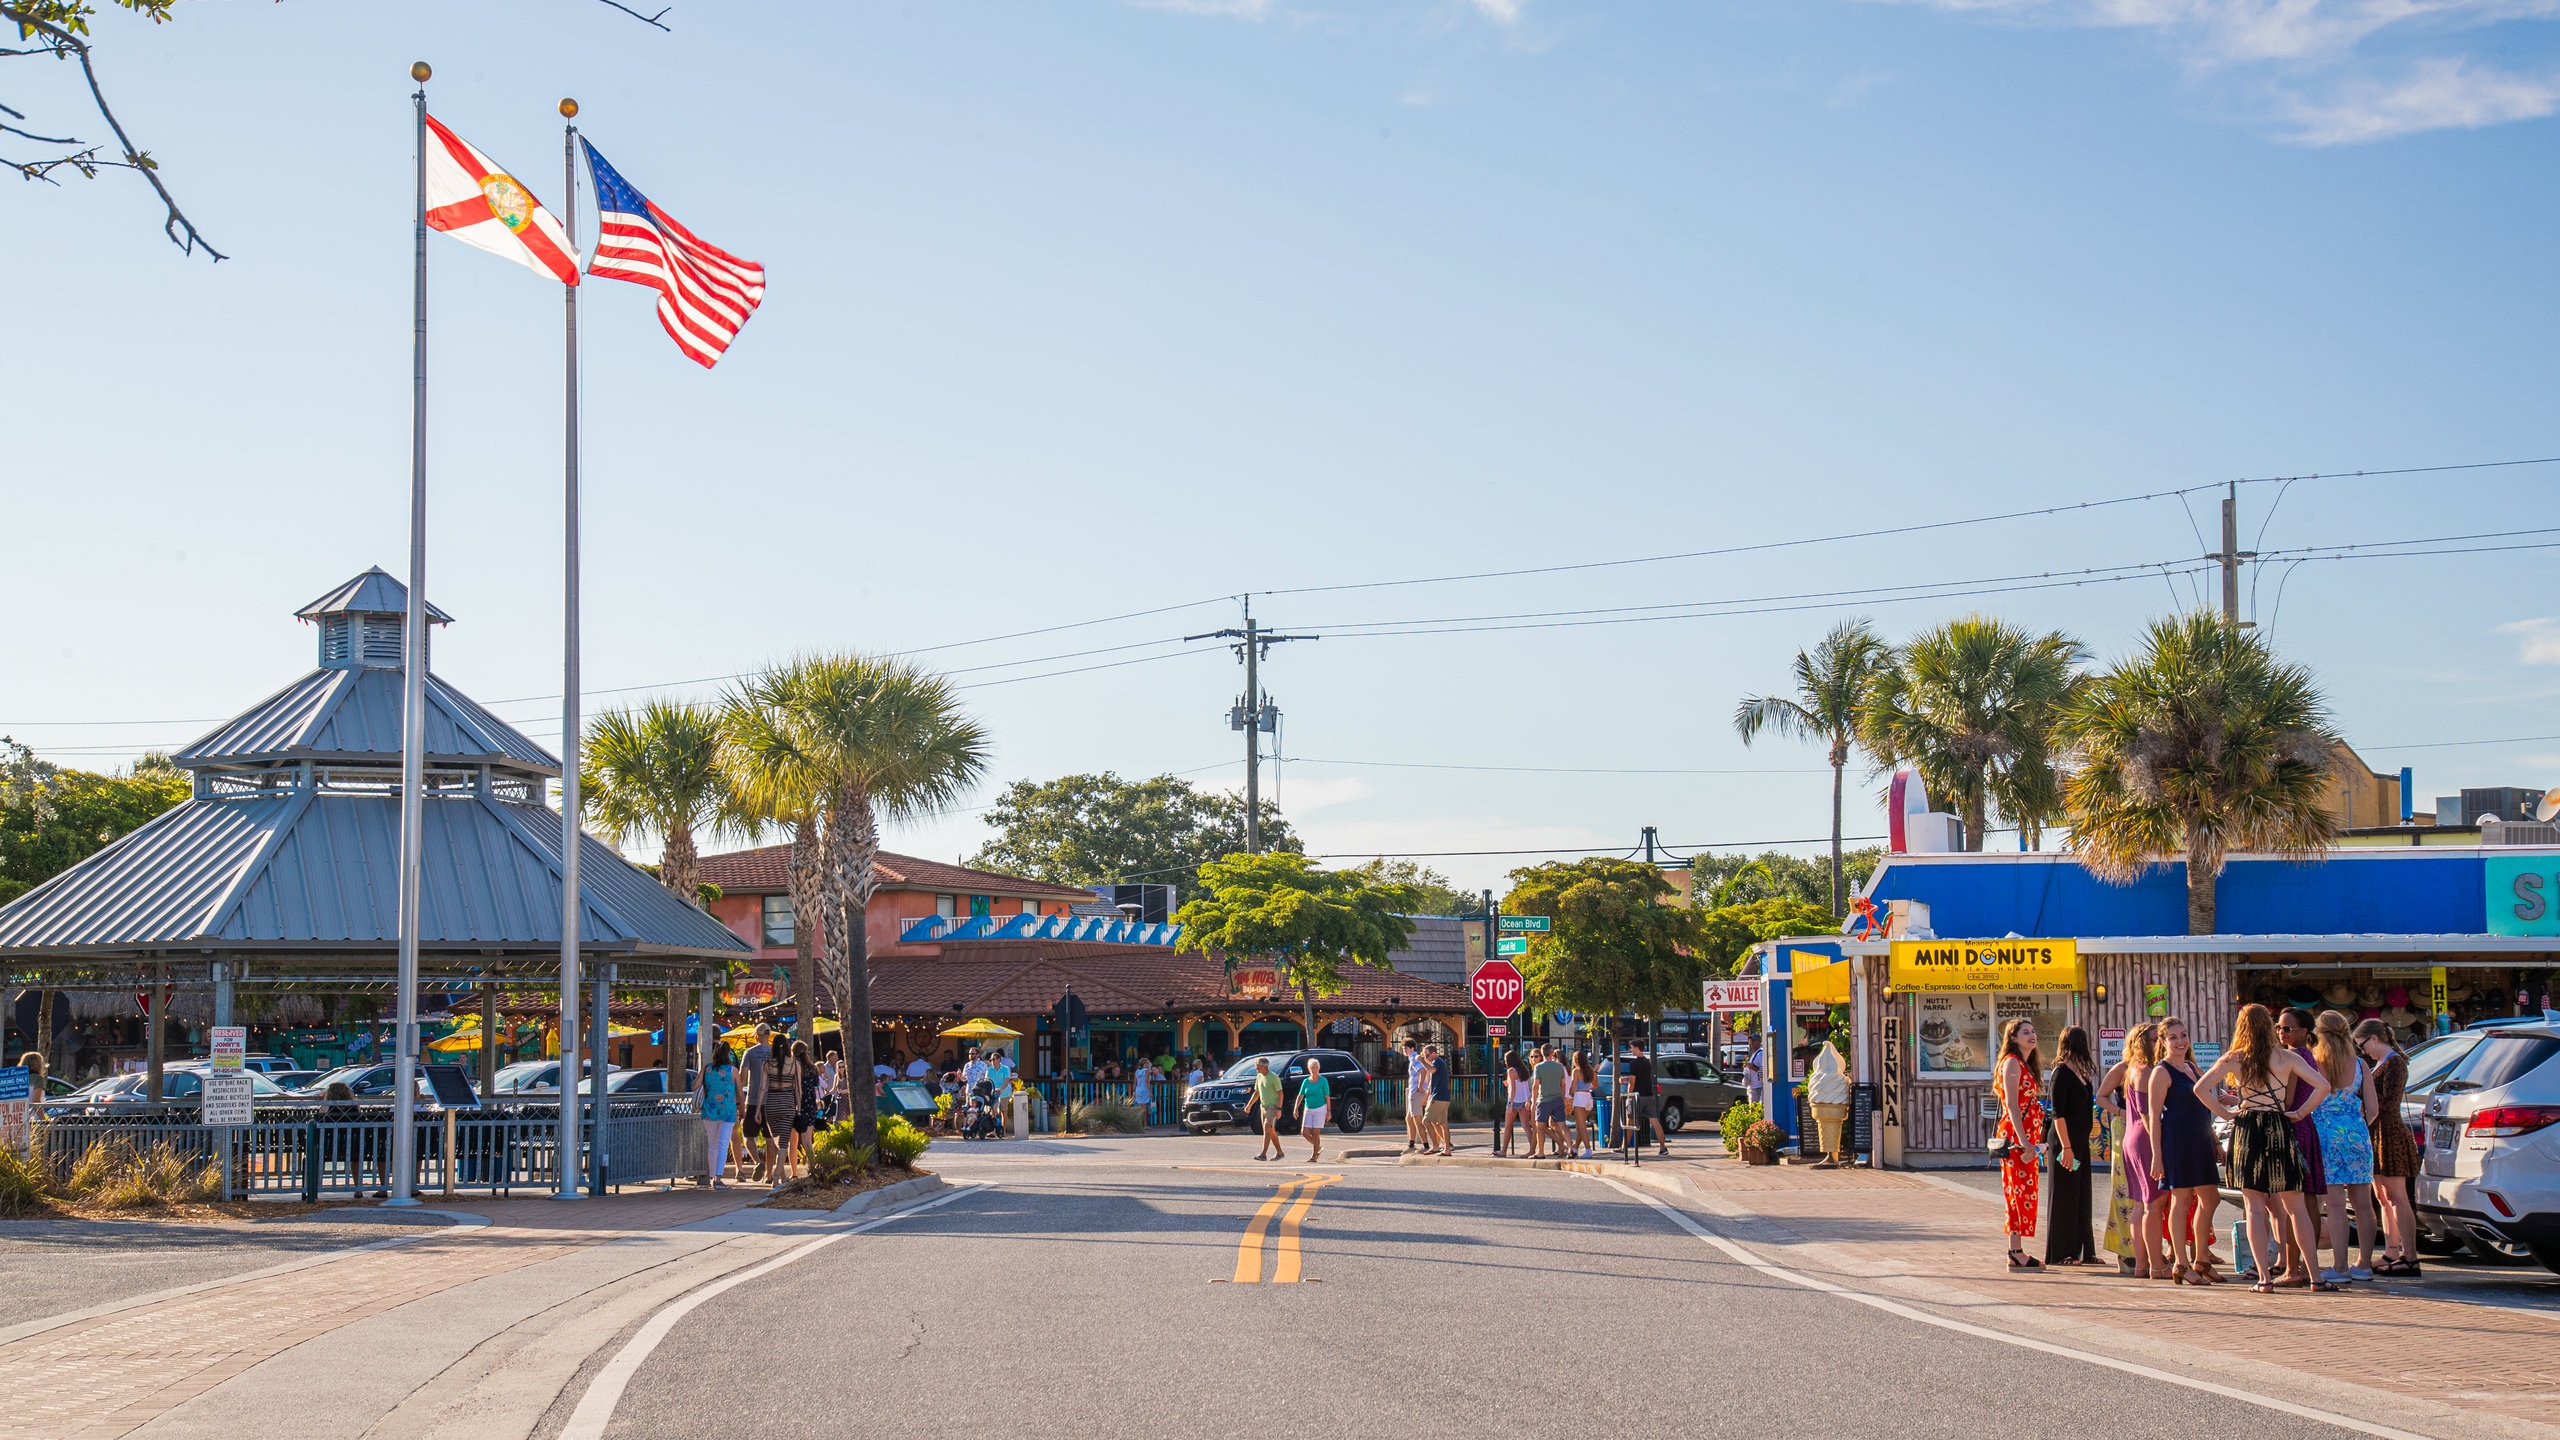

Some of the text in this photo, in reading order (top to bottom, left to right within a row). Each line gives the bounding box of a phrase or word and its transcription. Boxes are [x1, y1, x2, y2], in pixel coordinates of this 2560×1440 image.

[2514, 872, 2560, 921] S
[1501, 918, 1541, 928] Ocean Blvd
[1914, 948, 2052, 966] MINI DONUTS
[1252, 970, 1276, 984] HUB
[744, 981, 776, 995] HUB
[1475, 979, 1519, 1000] STOP
[1895, 983, 1920, 991] Coffee
[1924, 983, 1961, 991] Espresso
[1978, 982, 2004, 990] Coffee
[2032, 982, 2045, 990] Ice
[2046, 982, 2073, 990] Cream
[1727, 986, 1759, 1002] VALET
[731, 996, 767, 1006] Baja-Grill
[1997, 1002, 2040, 1010] SPECIALTY
[1997, 1009, 2040, 1017] COFFEES!
[1490, 1026, 1505, 1034] 4-WAY
[2101, 1030, 2125, 1038] CAUTION
[2102, 1049, 2123, 1057] DONUTS
[1946, 1061, 1970, 1069] SUNDAE
[1884, 1019, 1899, 1126] HENNA
[3, 1113, 23, 1126] ZONE
